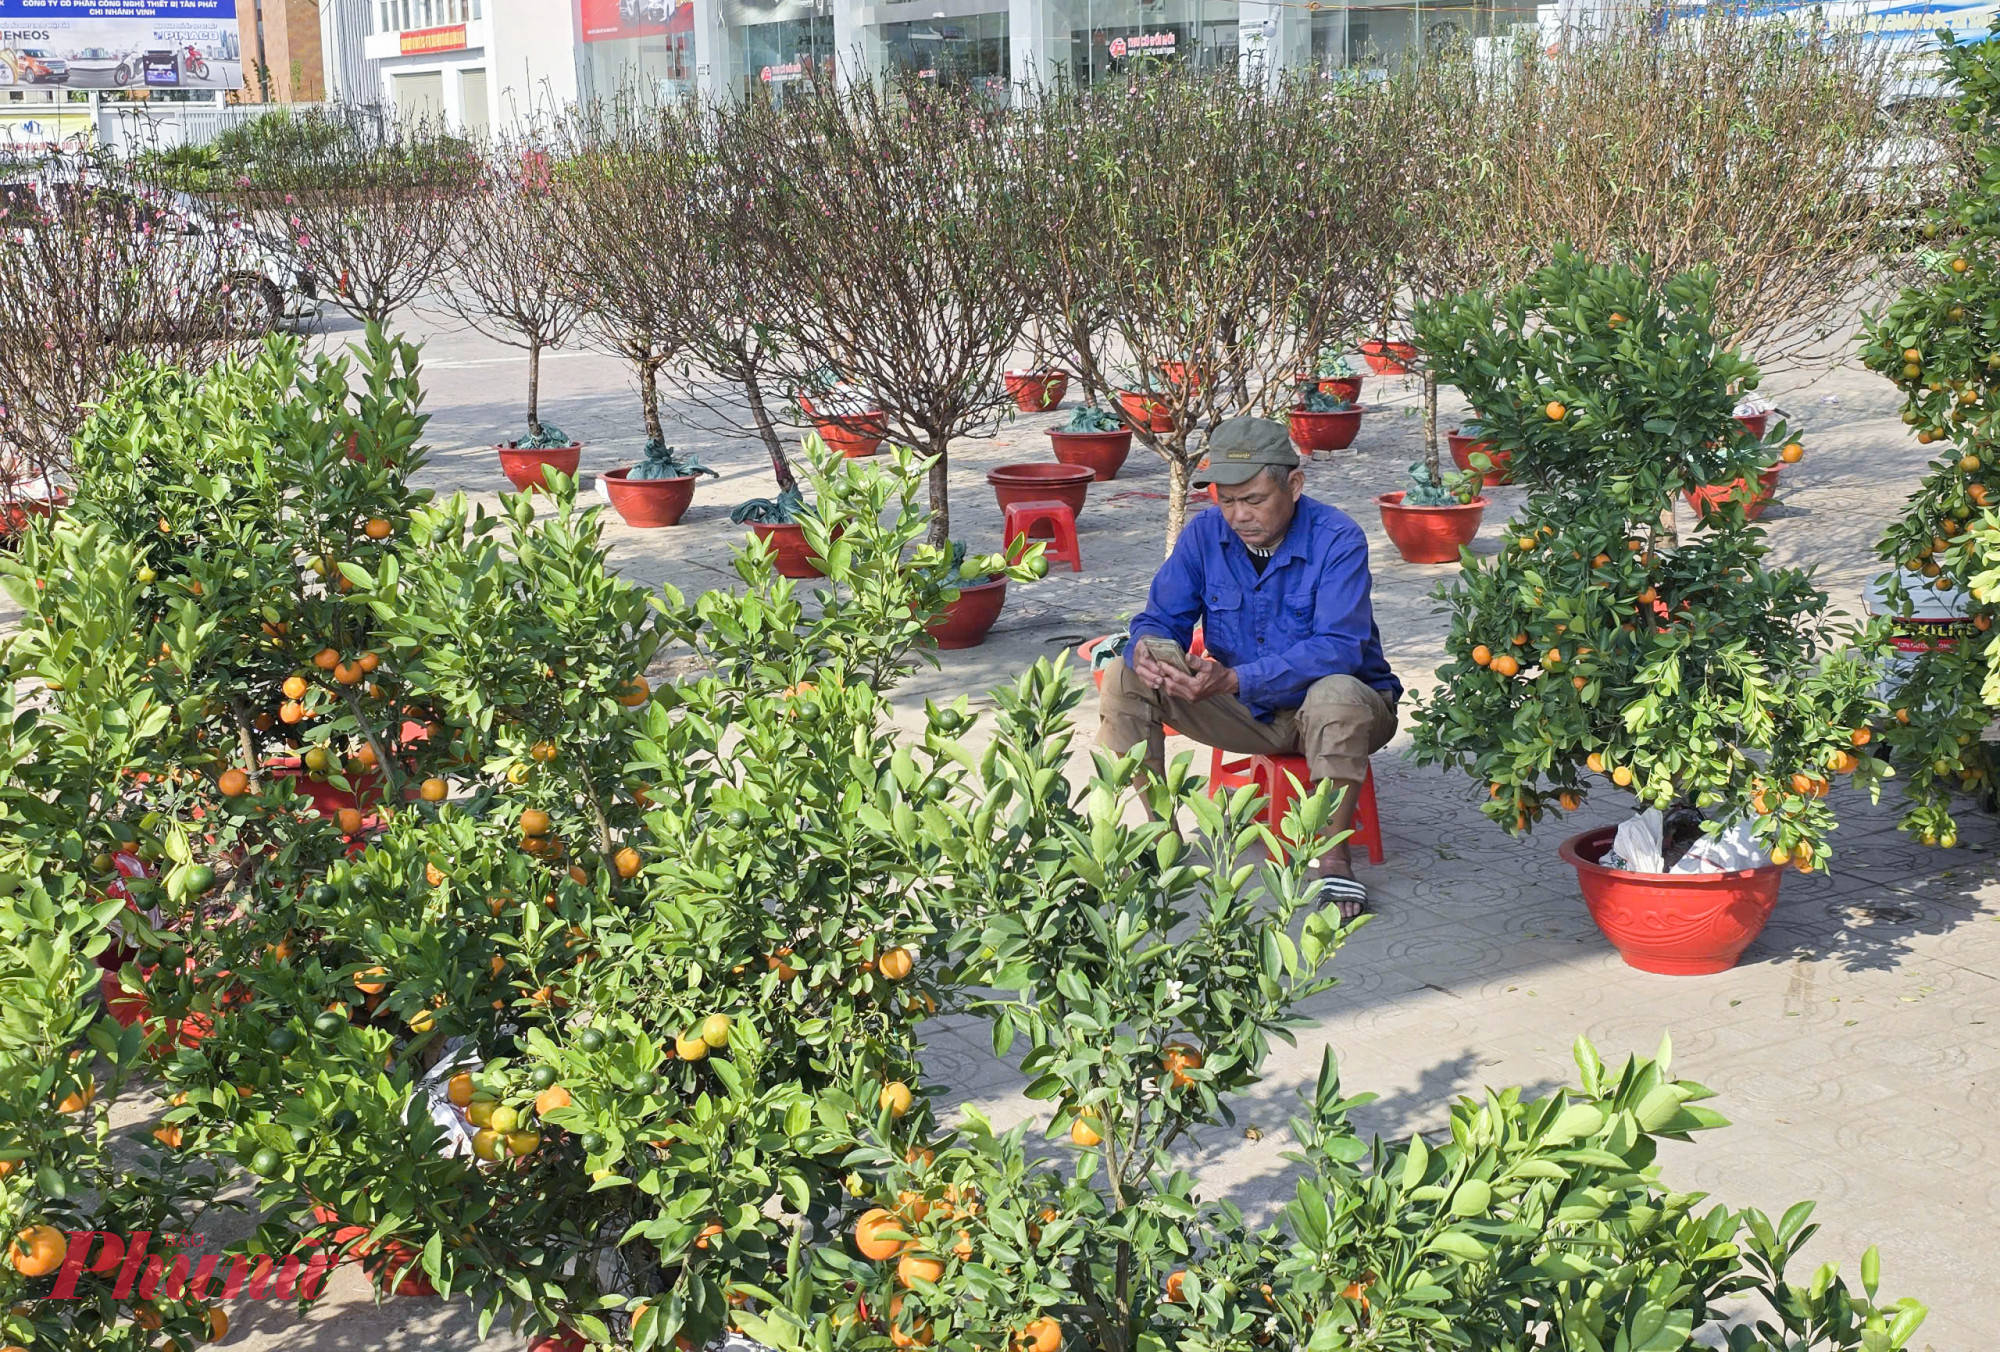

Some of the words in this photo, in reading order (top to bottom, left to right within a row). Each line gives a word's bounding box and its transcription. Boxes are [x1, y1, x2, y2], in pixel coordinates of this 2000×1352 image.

[89, 8, 103, 16] CHI
[105, 7, 135, 16] NHÁNH
[136, 8, 156, 16] VINH
[3, 30, 50, 41] ENEOS
[164, 31, 219, 41] PINACO
